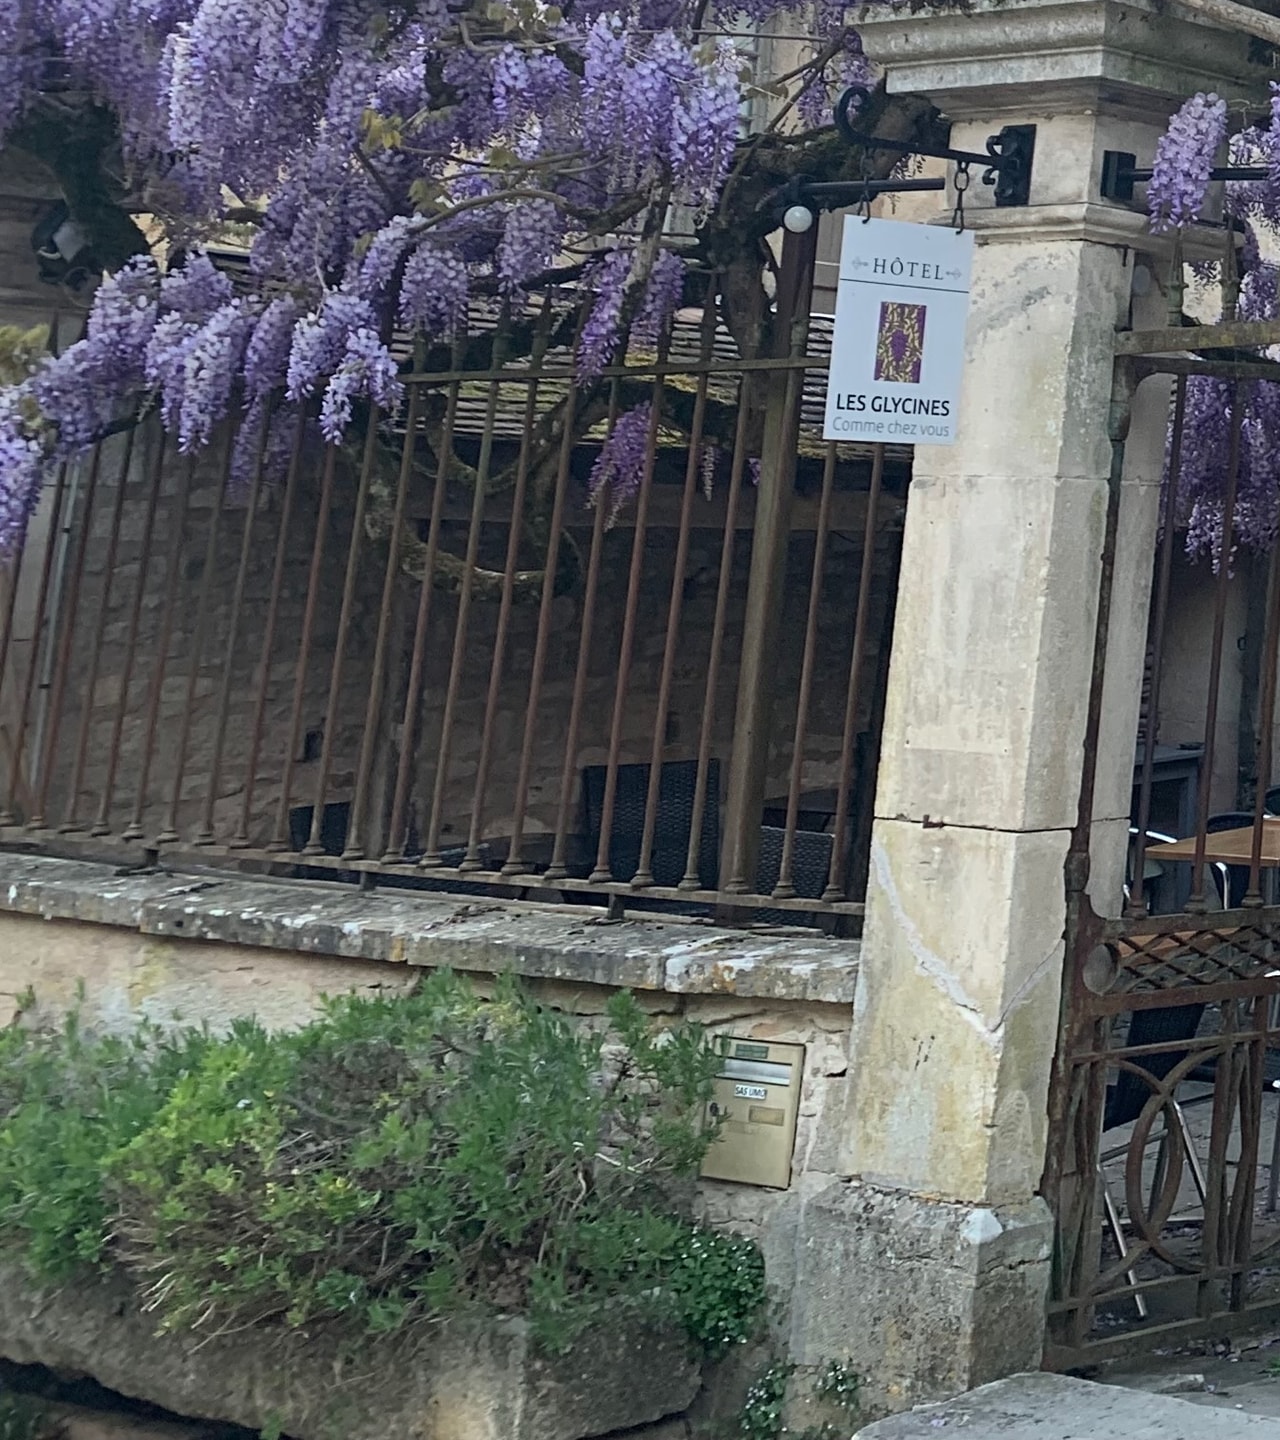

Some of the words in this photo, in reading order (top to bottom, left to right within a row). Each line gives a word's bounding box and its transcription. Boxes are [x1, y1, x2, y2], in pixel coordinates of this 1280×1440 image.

[873, 257, 944, 280] HÔTEL
[836, 393, 866, 411] LES
[871, 395, 950, 416] GLYCINES
[832, 417, 884, 433] Comme
[887, 419, 917, 435] chez
[920, 424, 950, 437] vous
